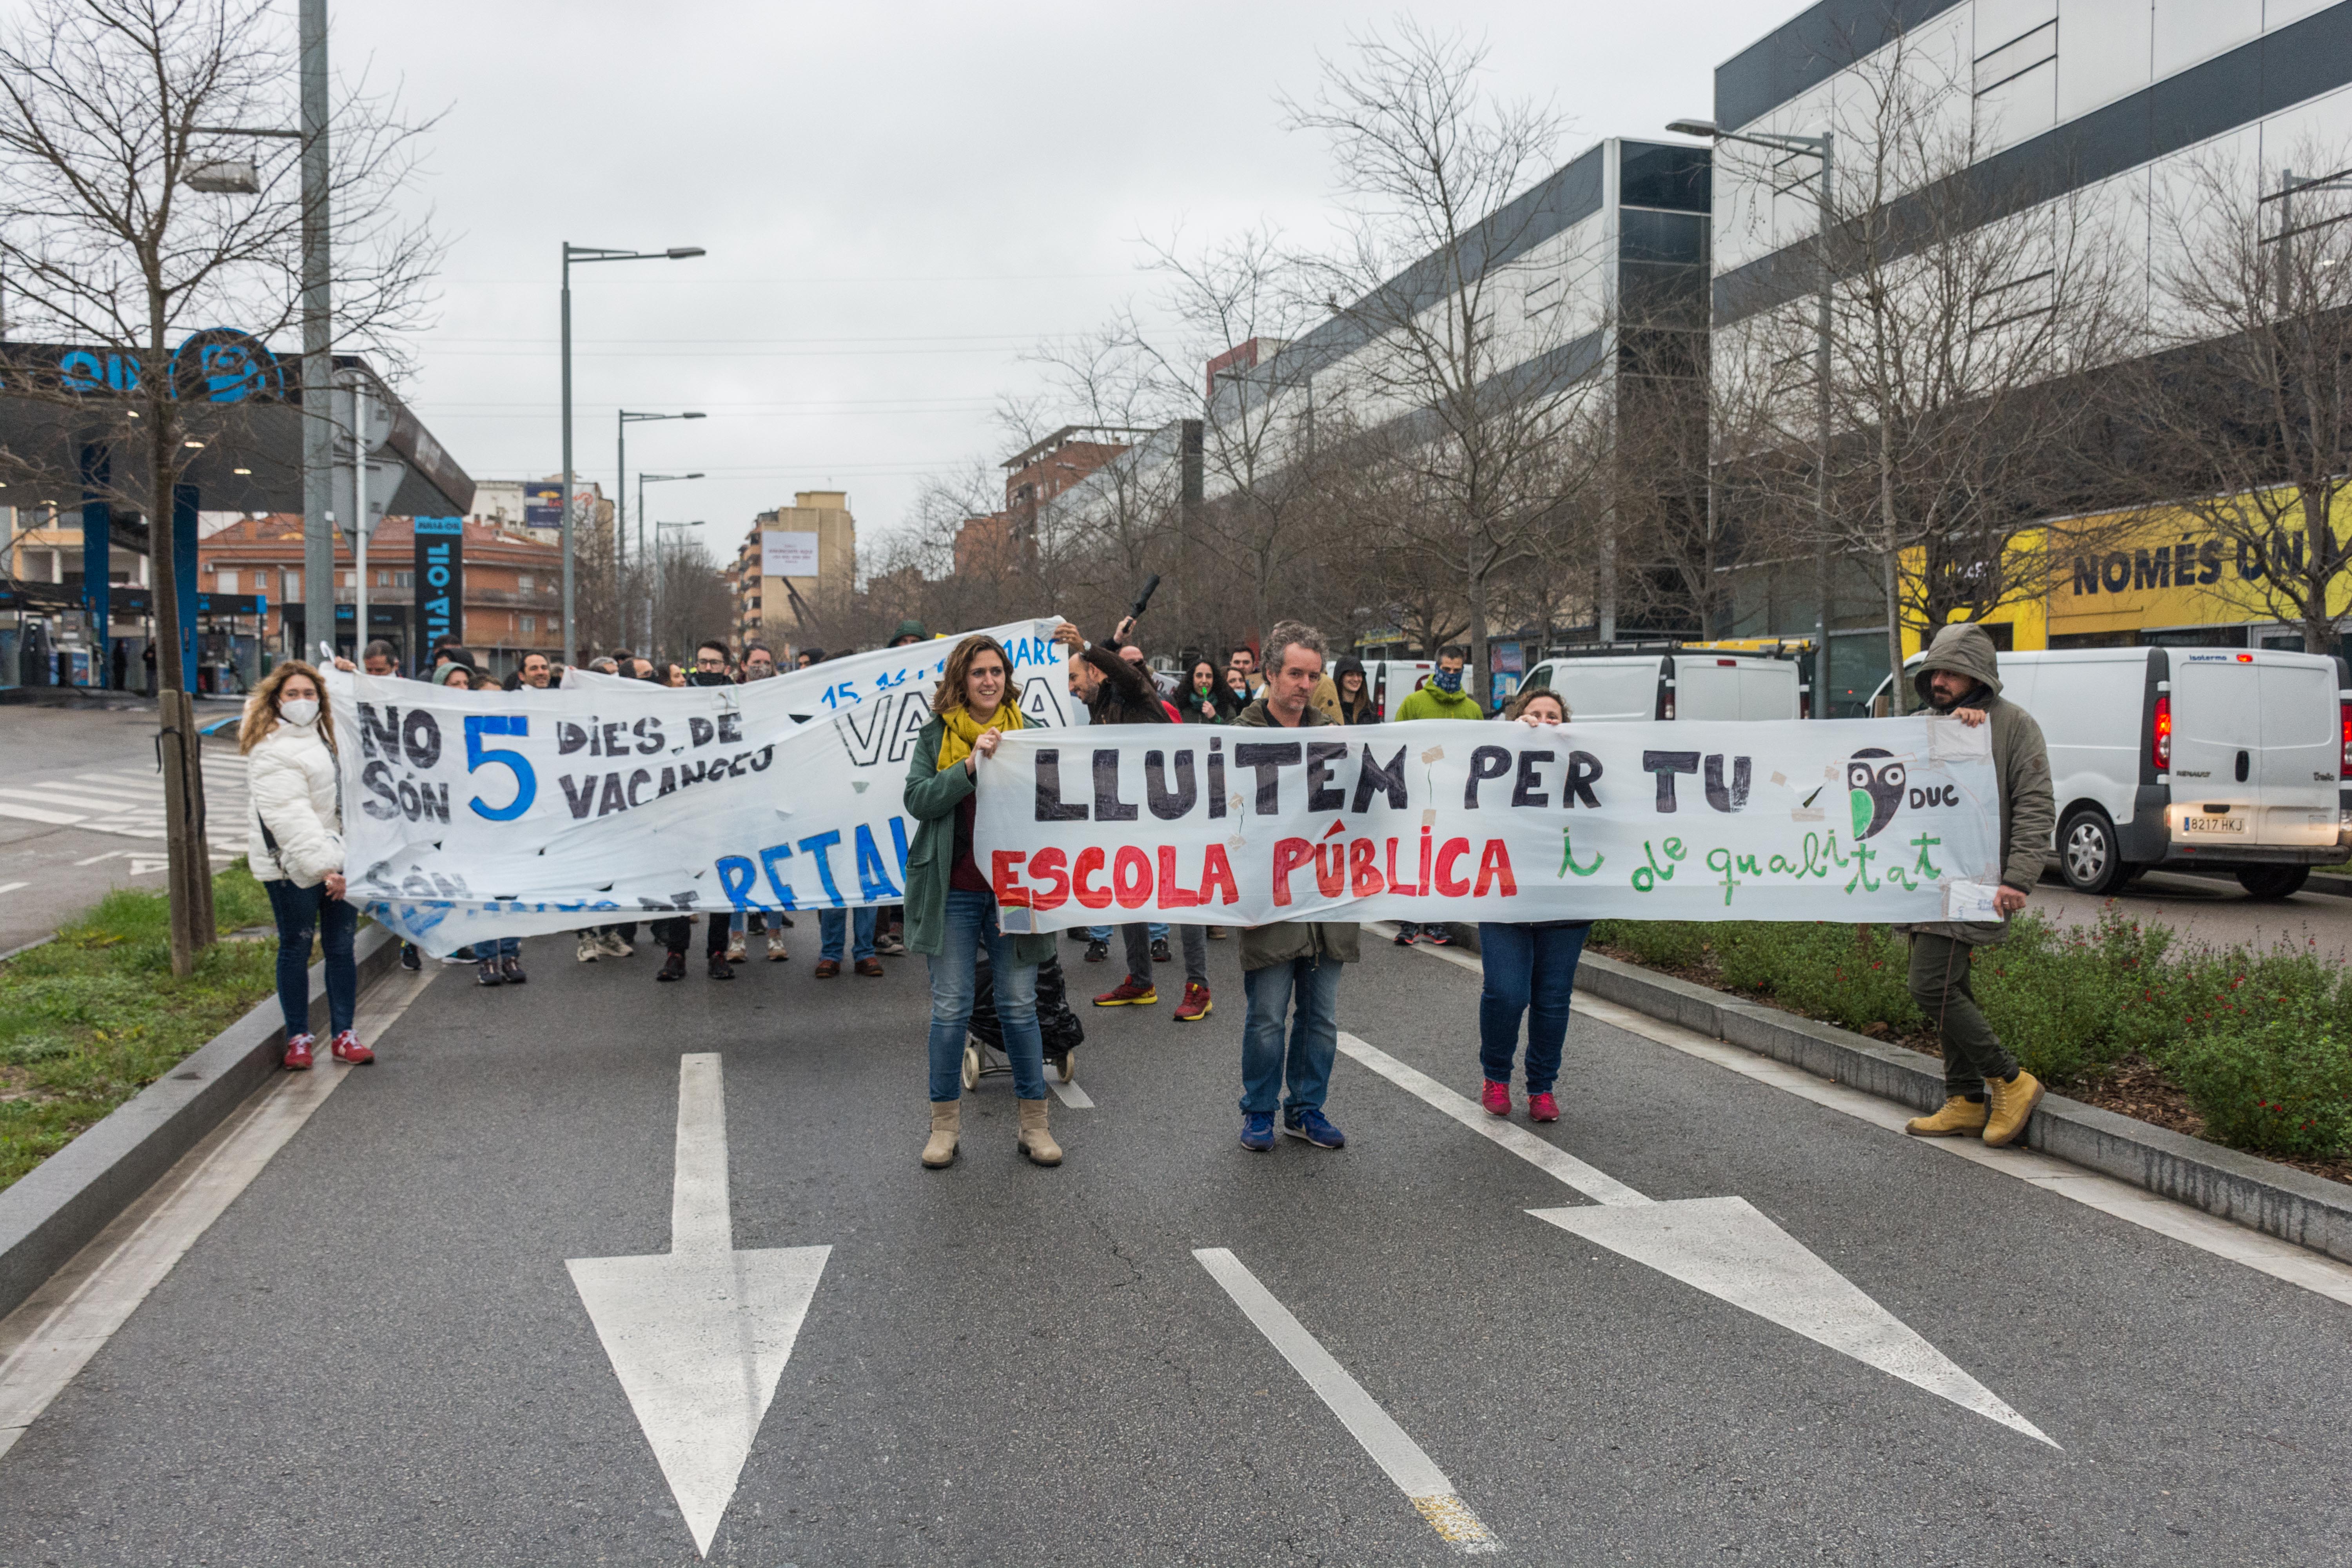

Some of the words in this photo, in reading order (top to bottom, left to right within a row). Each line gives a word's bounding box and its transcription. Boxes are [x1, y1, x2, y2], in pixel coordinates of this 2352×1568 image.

[2074, 533, 2223, 595] NOMÉS
[357, 702, 441, 769] NO
[689, 712, 743, 748] DE
[362, 760, 451, 825] SÓN
[464, 715, 537, 821] 5
[1464, 745, 1603, 810] PER
[1642, 750, 1751, 813] TU
[1909, 784, 1959, 809] DUC
[2191, 819, 2218, 830] 8217
[2221, 820, 2242, 831] HKJ
[992, 844, 1240, 911] ESCOLA
[1558, 827, 1605, 879] i
[1630, 837, 1688, 893] de
[1706, 829, 1942, 906] qualitat
